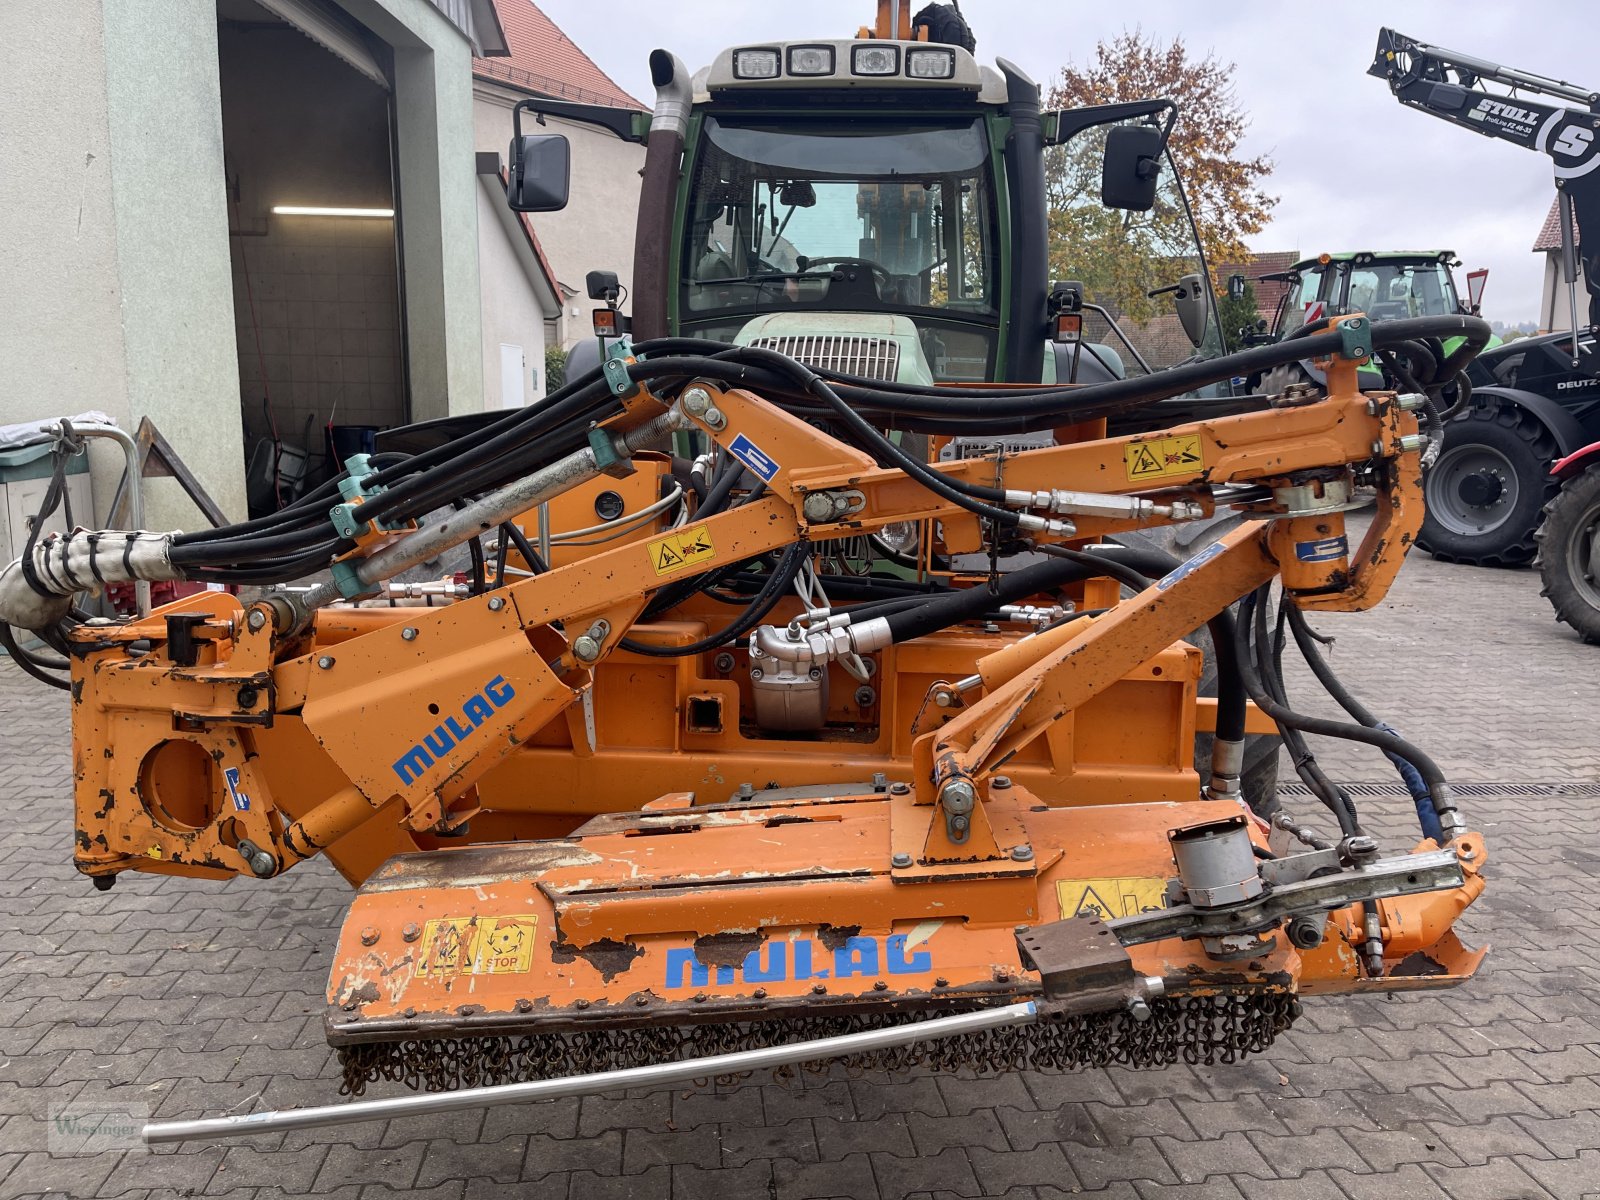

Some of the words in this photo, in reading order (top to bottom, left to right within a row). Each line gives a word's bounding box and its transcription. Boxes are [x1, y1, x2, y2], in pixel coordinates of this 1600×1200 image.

[1477, 99, 1539, 126] STOLL
[1553, 124, 1594, 157] S
[392, 674, 516, 786] MULAG
[486, 957, 518, 968] STOP
